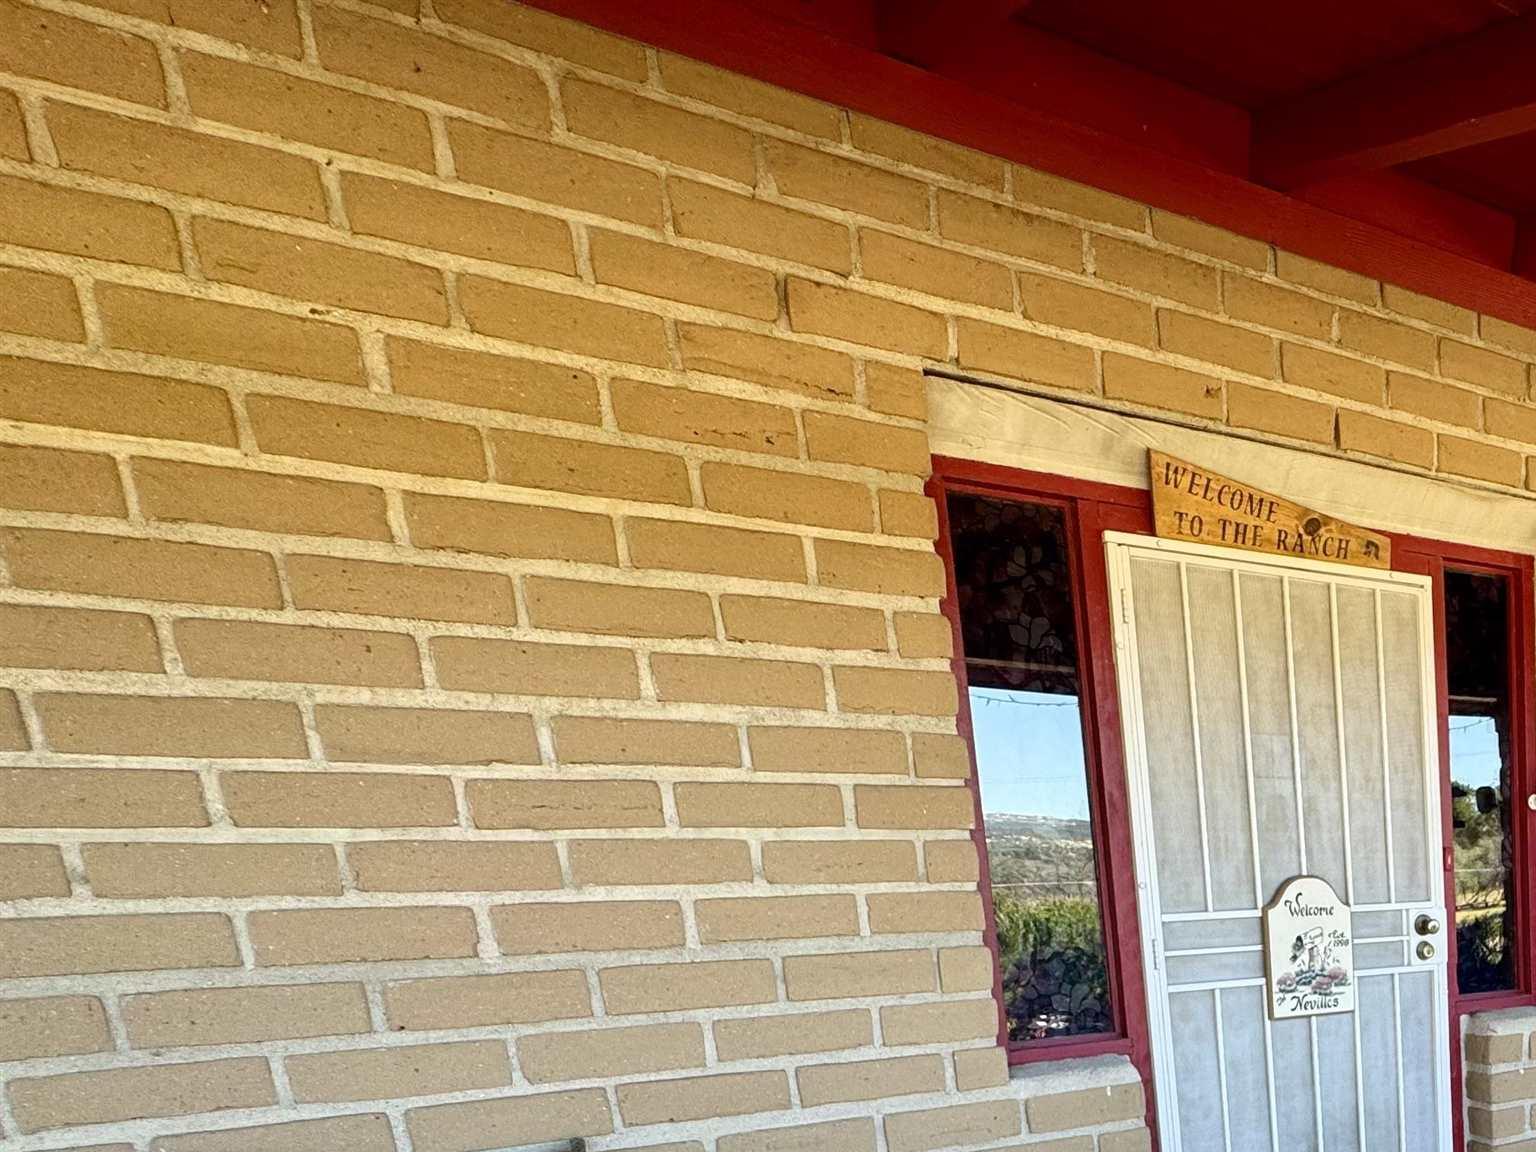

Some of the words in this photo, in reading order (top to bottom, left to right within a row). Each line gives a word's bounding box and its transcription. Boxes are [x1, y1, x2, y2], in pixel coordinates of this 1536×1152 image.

[1162, 461, 1280, 524] WELCOME
[1173, 510, 1204, 538] TO
[1217, 517, 1264, 548] THE
[1276, 529, 1351, 560] RANCH
[1284, 892, 1335, 917] Welcome
[1291, 994, 1339, 1012] Nevilles
